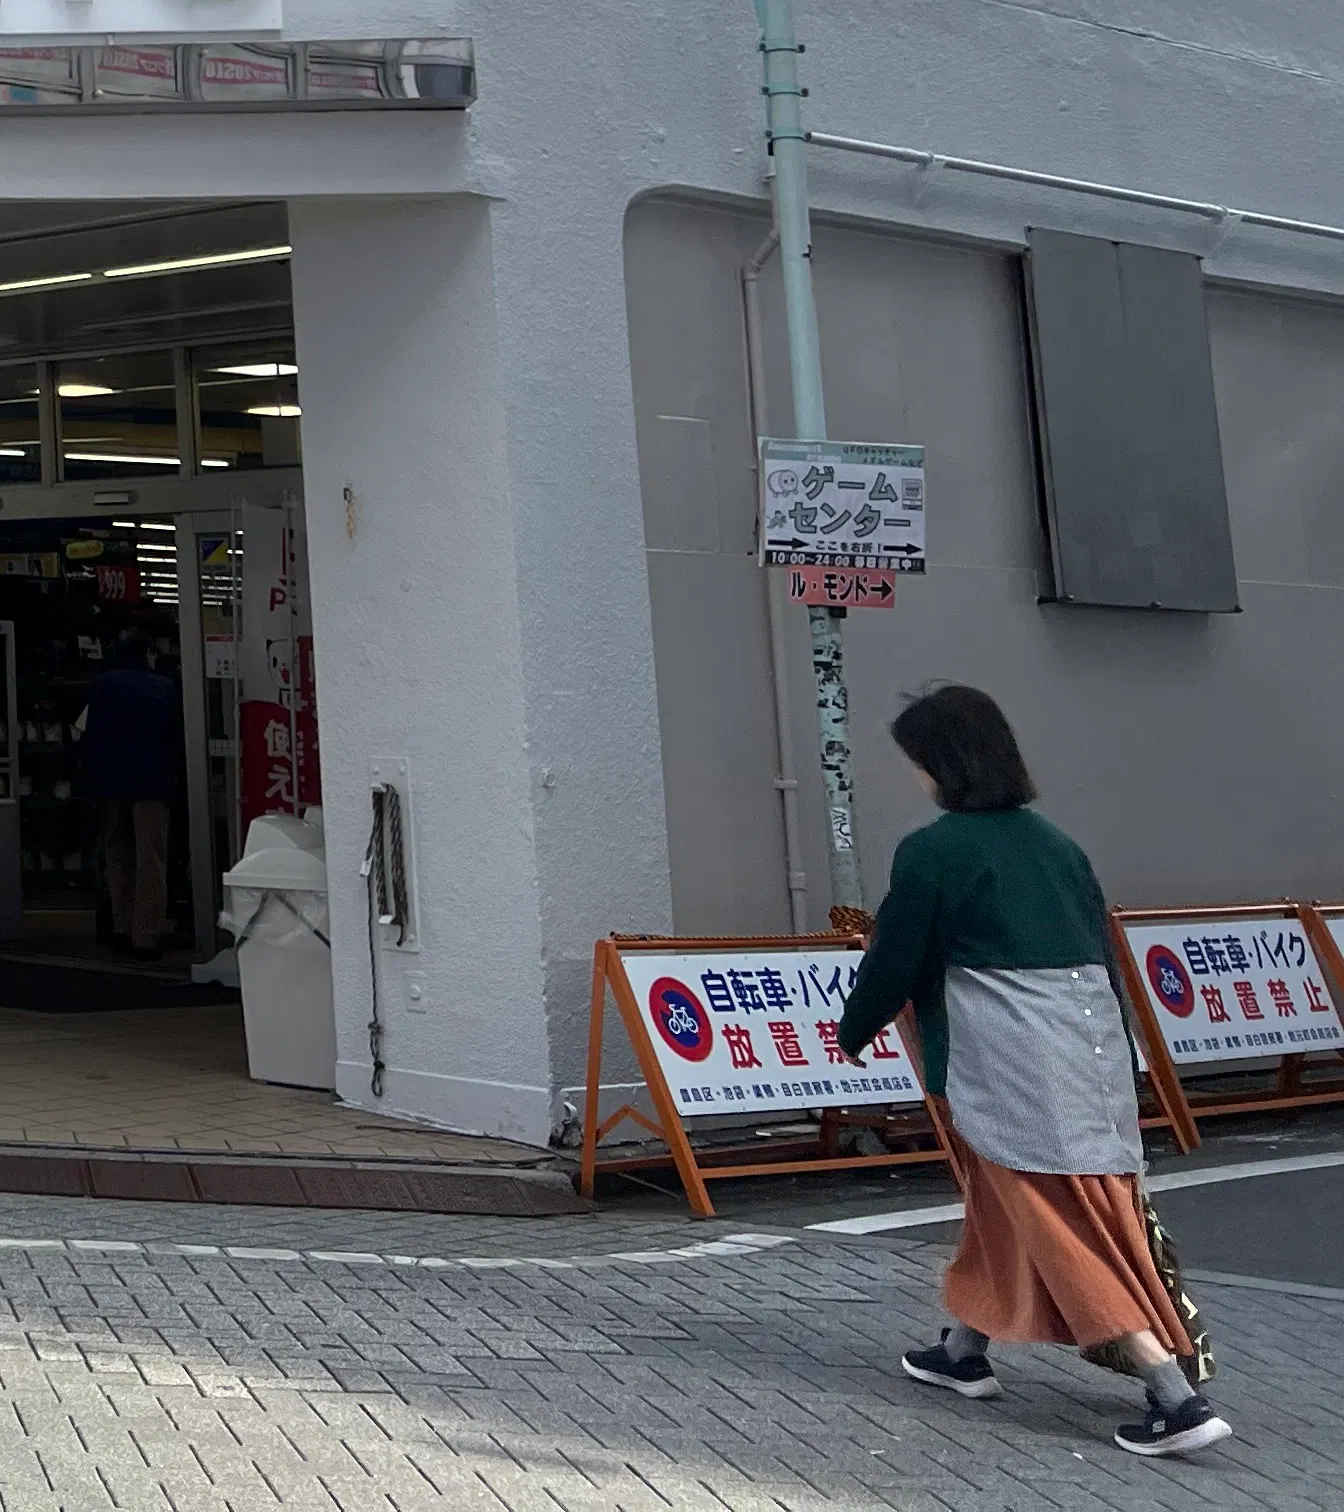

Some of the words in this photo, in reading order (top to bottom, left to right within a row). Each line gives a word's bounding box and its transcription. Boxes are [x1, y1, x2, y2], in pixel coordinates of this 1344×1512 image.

[802, 465, 898, 503] ゲーム
[788, 501, 911, 538] センター
[790, 570, 869, 602] ル・モンド
[1182, 930, 1306, 977] 自転車・バイク
[1200, 976, 1329, 1024] 放置禁止
